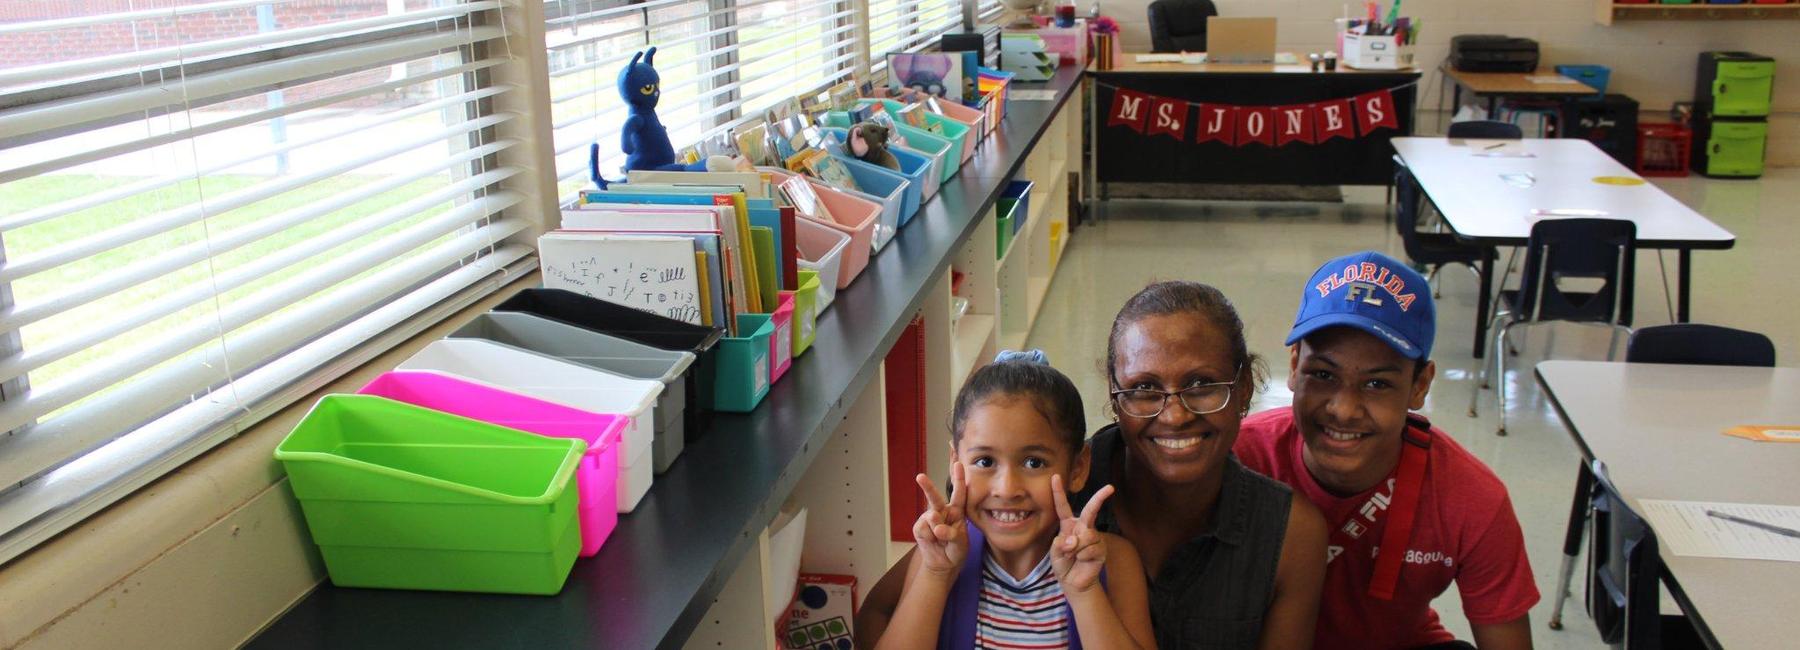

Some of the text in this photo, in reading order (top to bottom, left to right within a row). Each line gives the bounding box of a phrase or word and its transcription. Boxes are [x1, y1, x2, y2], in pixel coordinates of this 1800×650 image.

[1117, 94, 1385, 137] MS. JONES
[1316, 262, 1416, 312] FLORIDA
[1344, 281, 1382, 307] FL
